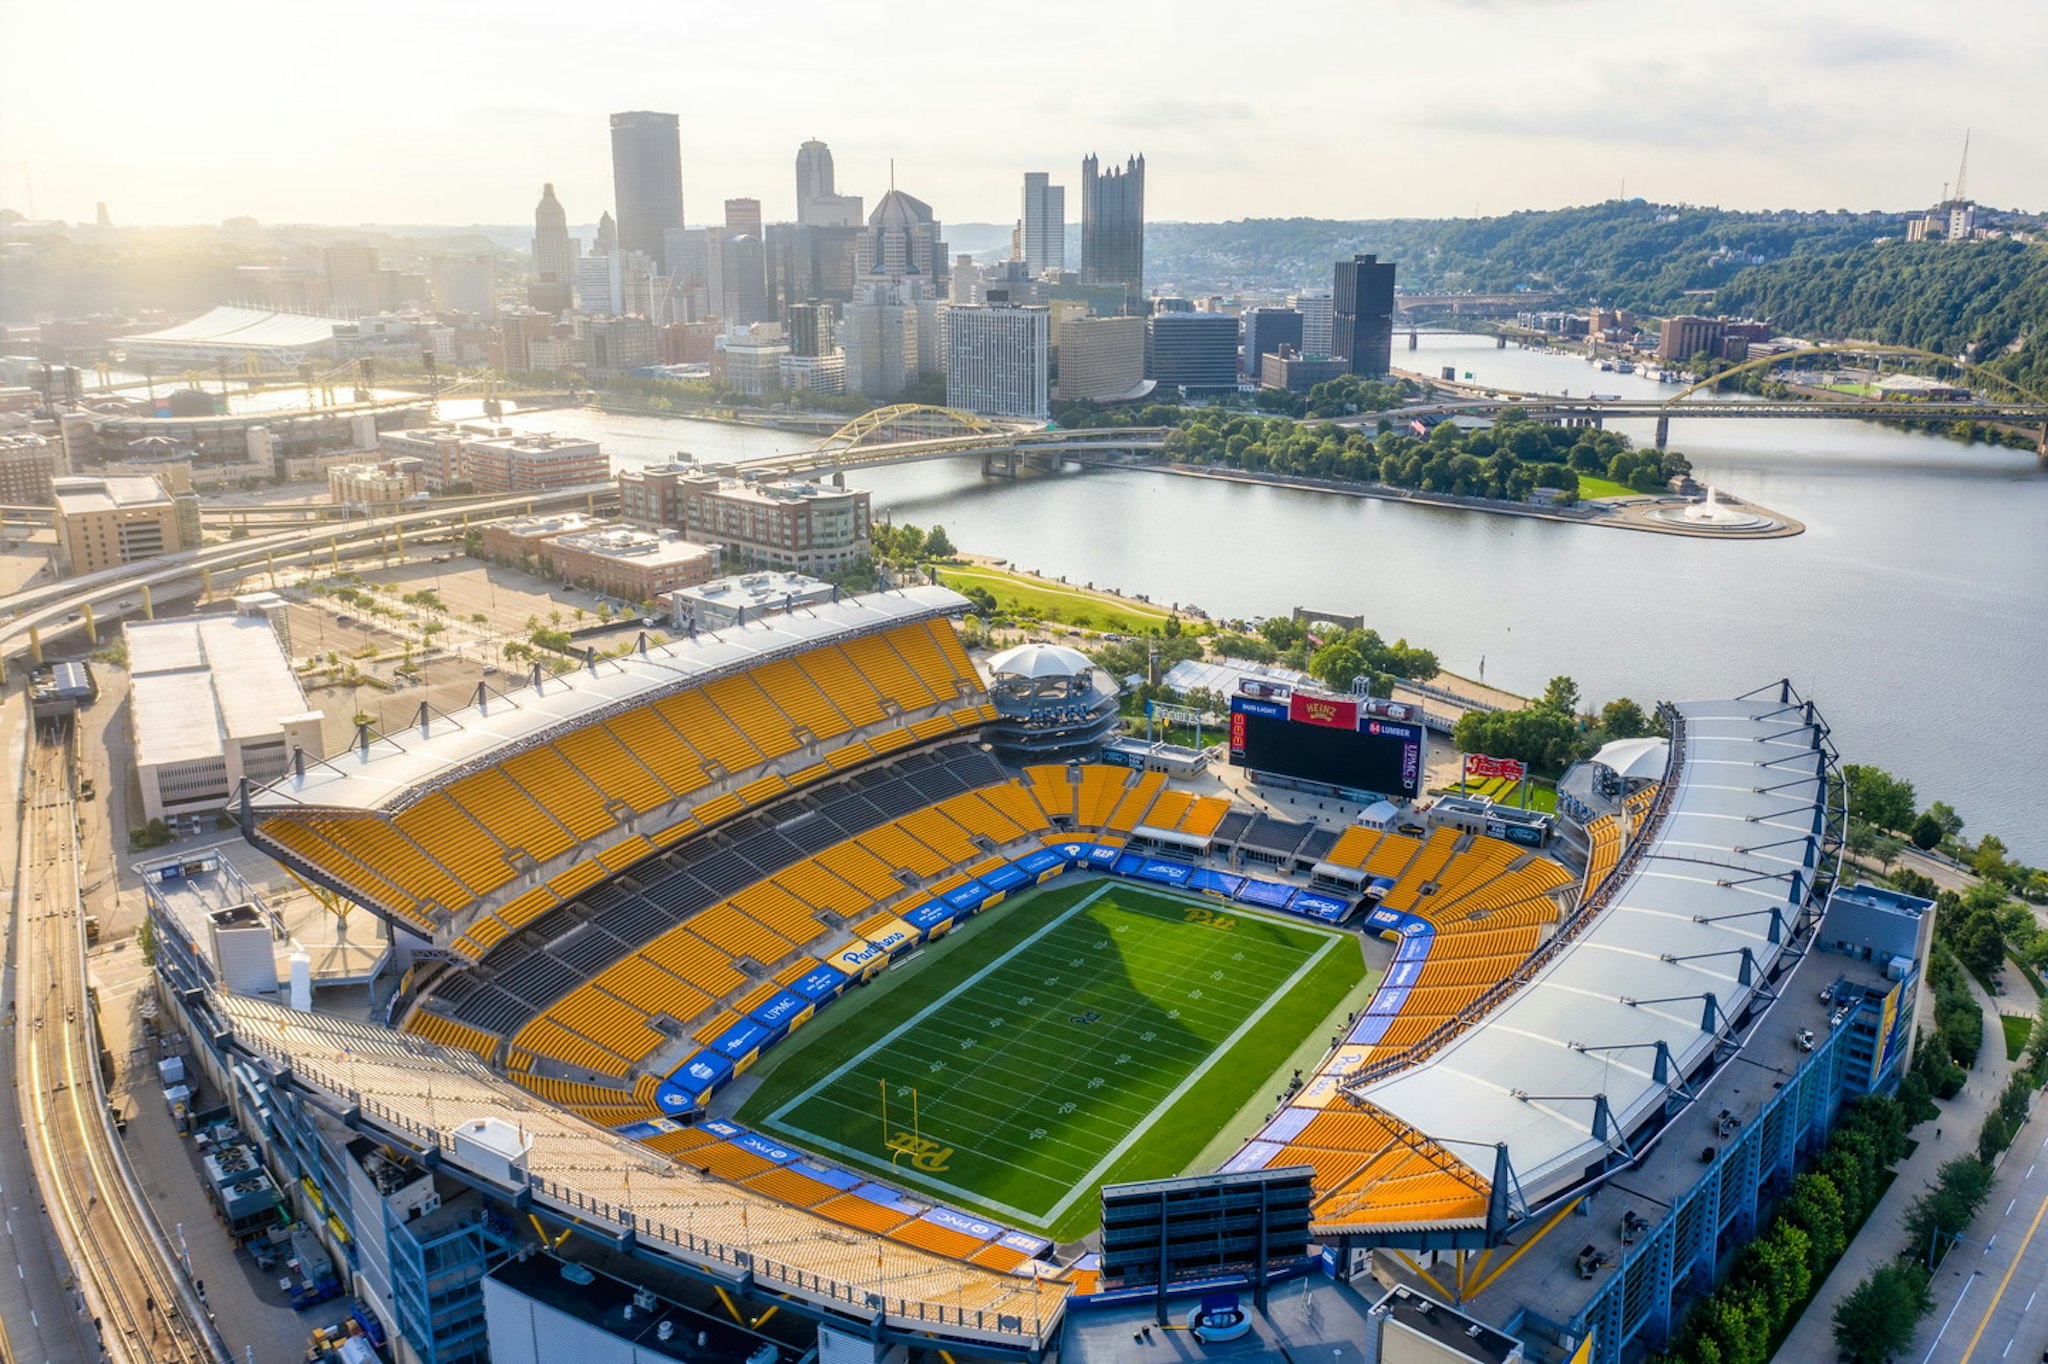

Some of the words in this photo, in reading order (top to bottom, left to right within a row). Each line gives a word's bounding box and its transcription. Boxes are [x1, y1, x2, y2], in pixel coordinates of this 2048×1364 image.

[1242, 703, 1257, 711] BUD
[1257, 706, 1277, 714] LIGHT
[1306, 703, 1337, 717] HEINZ
[1381, 725, 1410, 737] LUMBER
[1406, 744, 1418, 778] UPMC
[842, 931, 905, 965] Panthers
[764, 998, 796, 1020] UPMC
[744, 1135, 773, 1154] PNC
[936, 1213, 971, 1229] PNC
